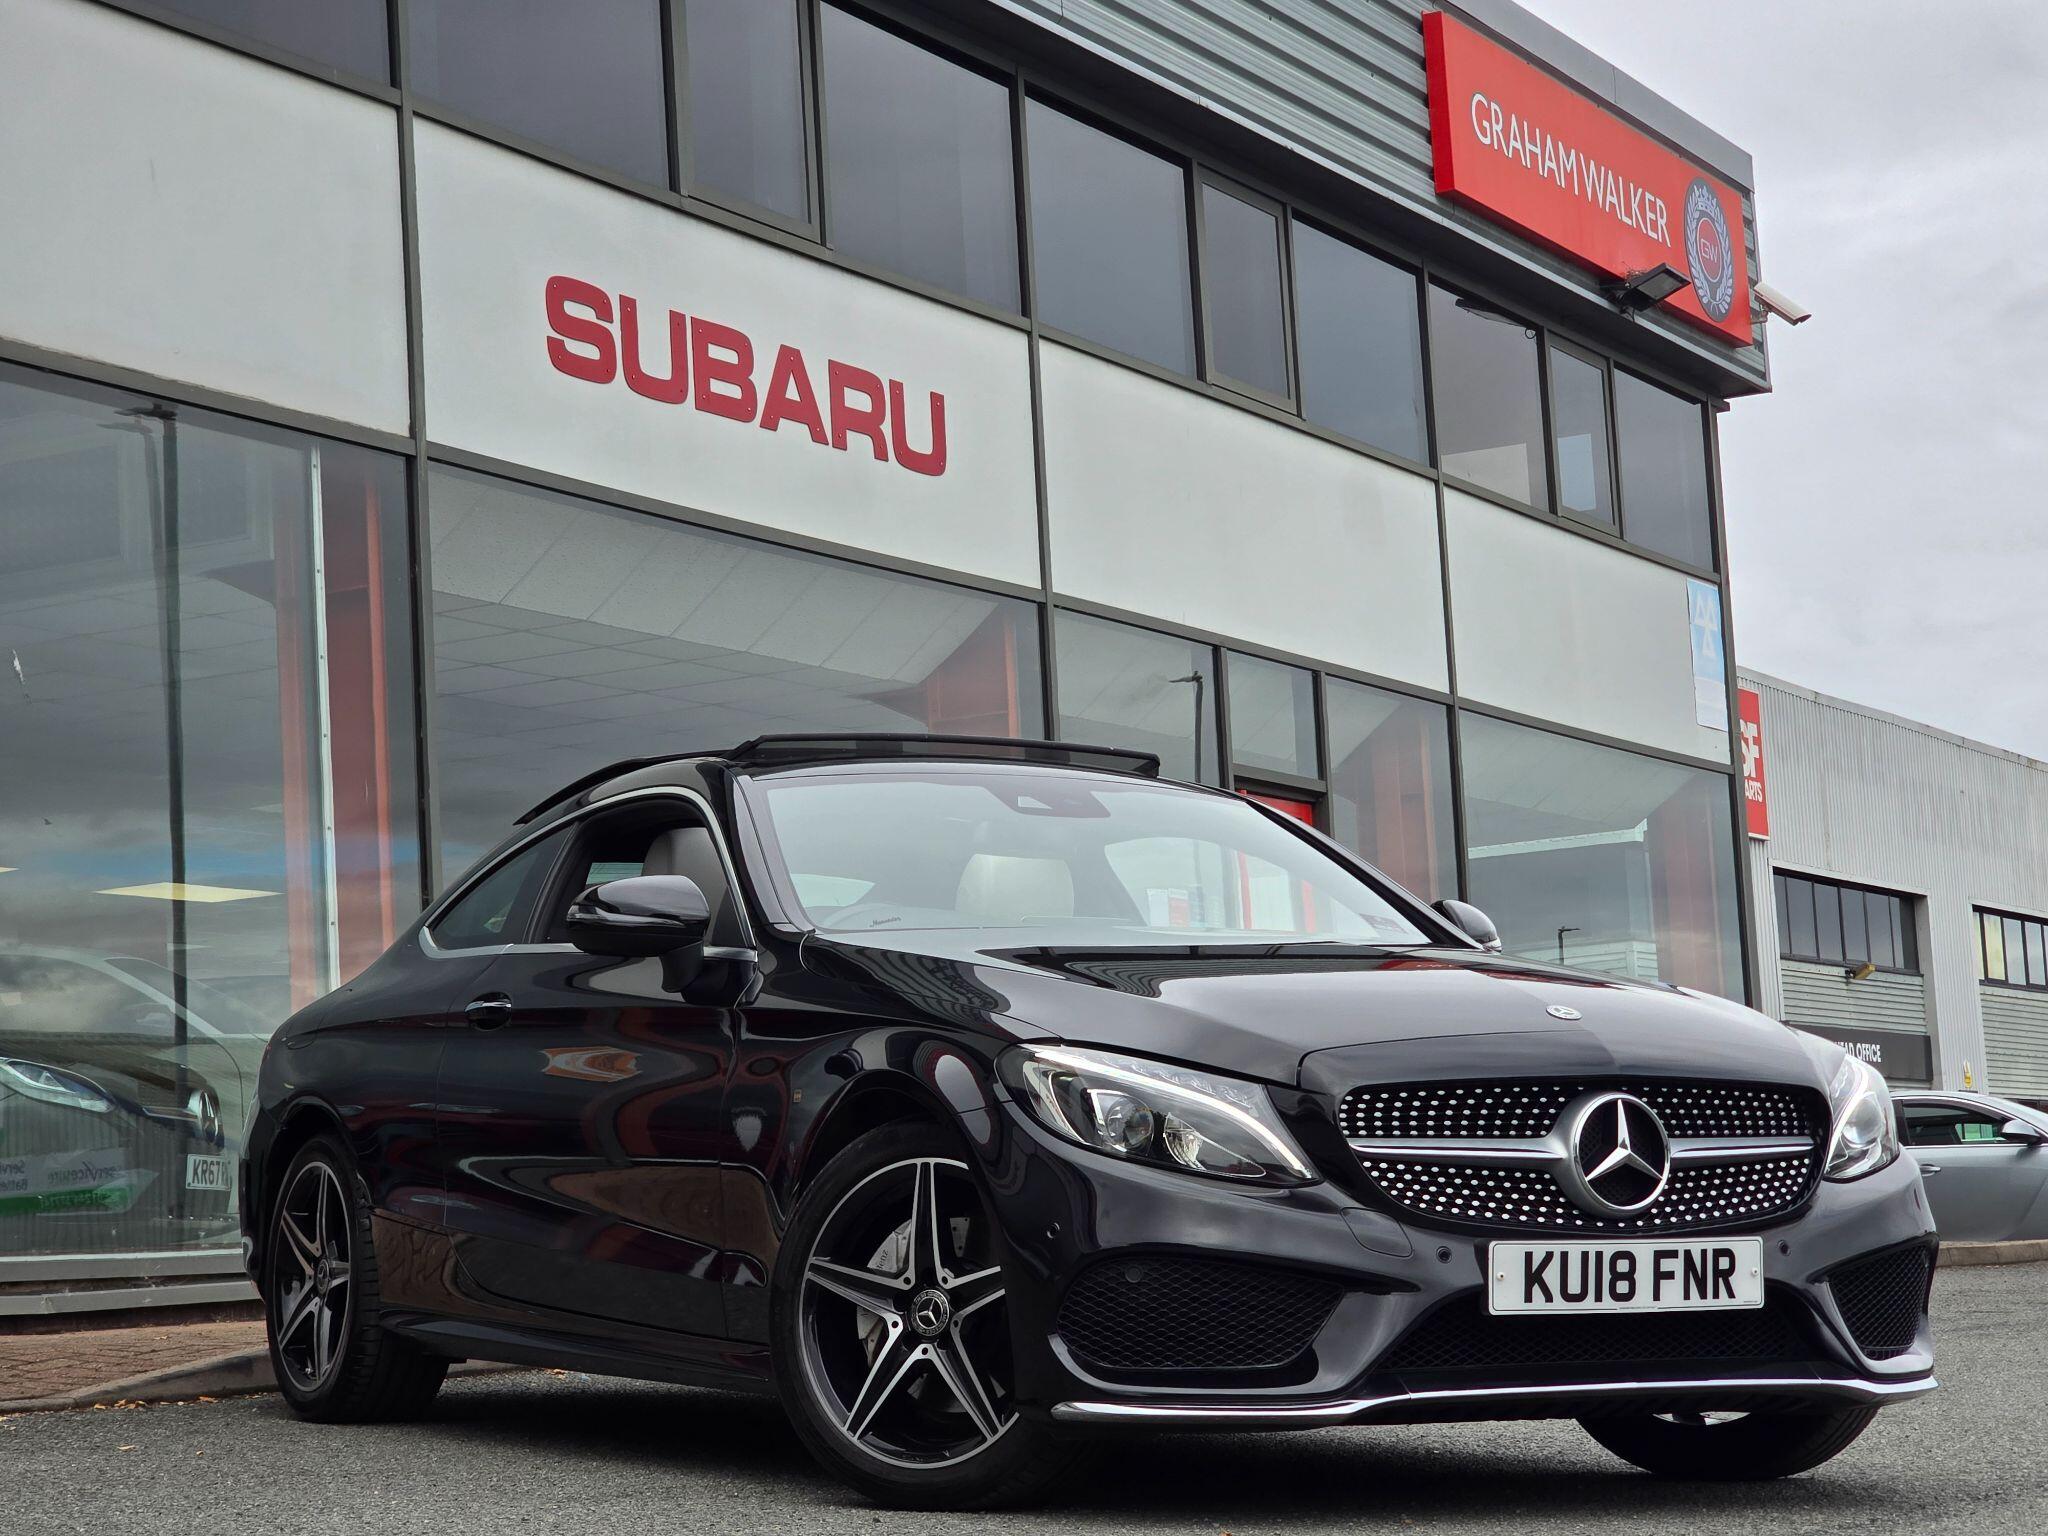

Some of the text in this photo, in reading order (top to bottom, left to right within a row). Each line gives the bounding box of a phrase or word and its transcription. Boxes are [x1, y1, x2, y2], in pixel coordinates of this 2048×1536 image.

[1471, 93, 1671, 247] GRAHAM WALKER
[1700, 238, 1718, 263] GW
[545, 275, 948, 477] SUBARU
[1856, 1042, 1882, 1063] OFFICE
[192, 1159, 221, 1186] KR67
[1524, 1248, 1736, 1303] KU18 FNR
